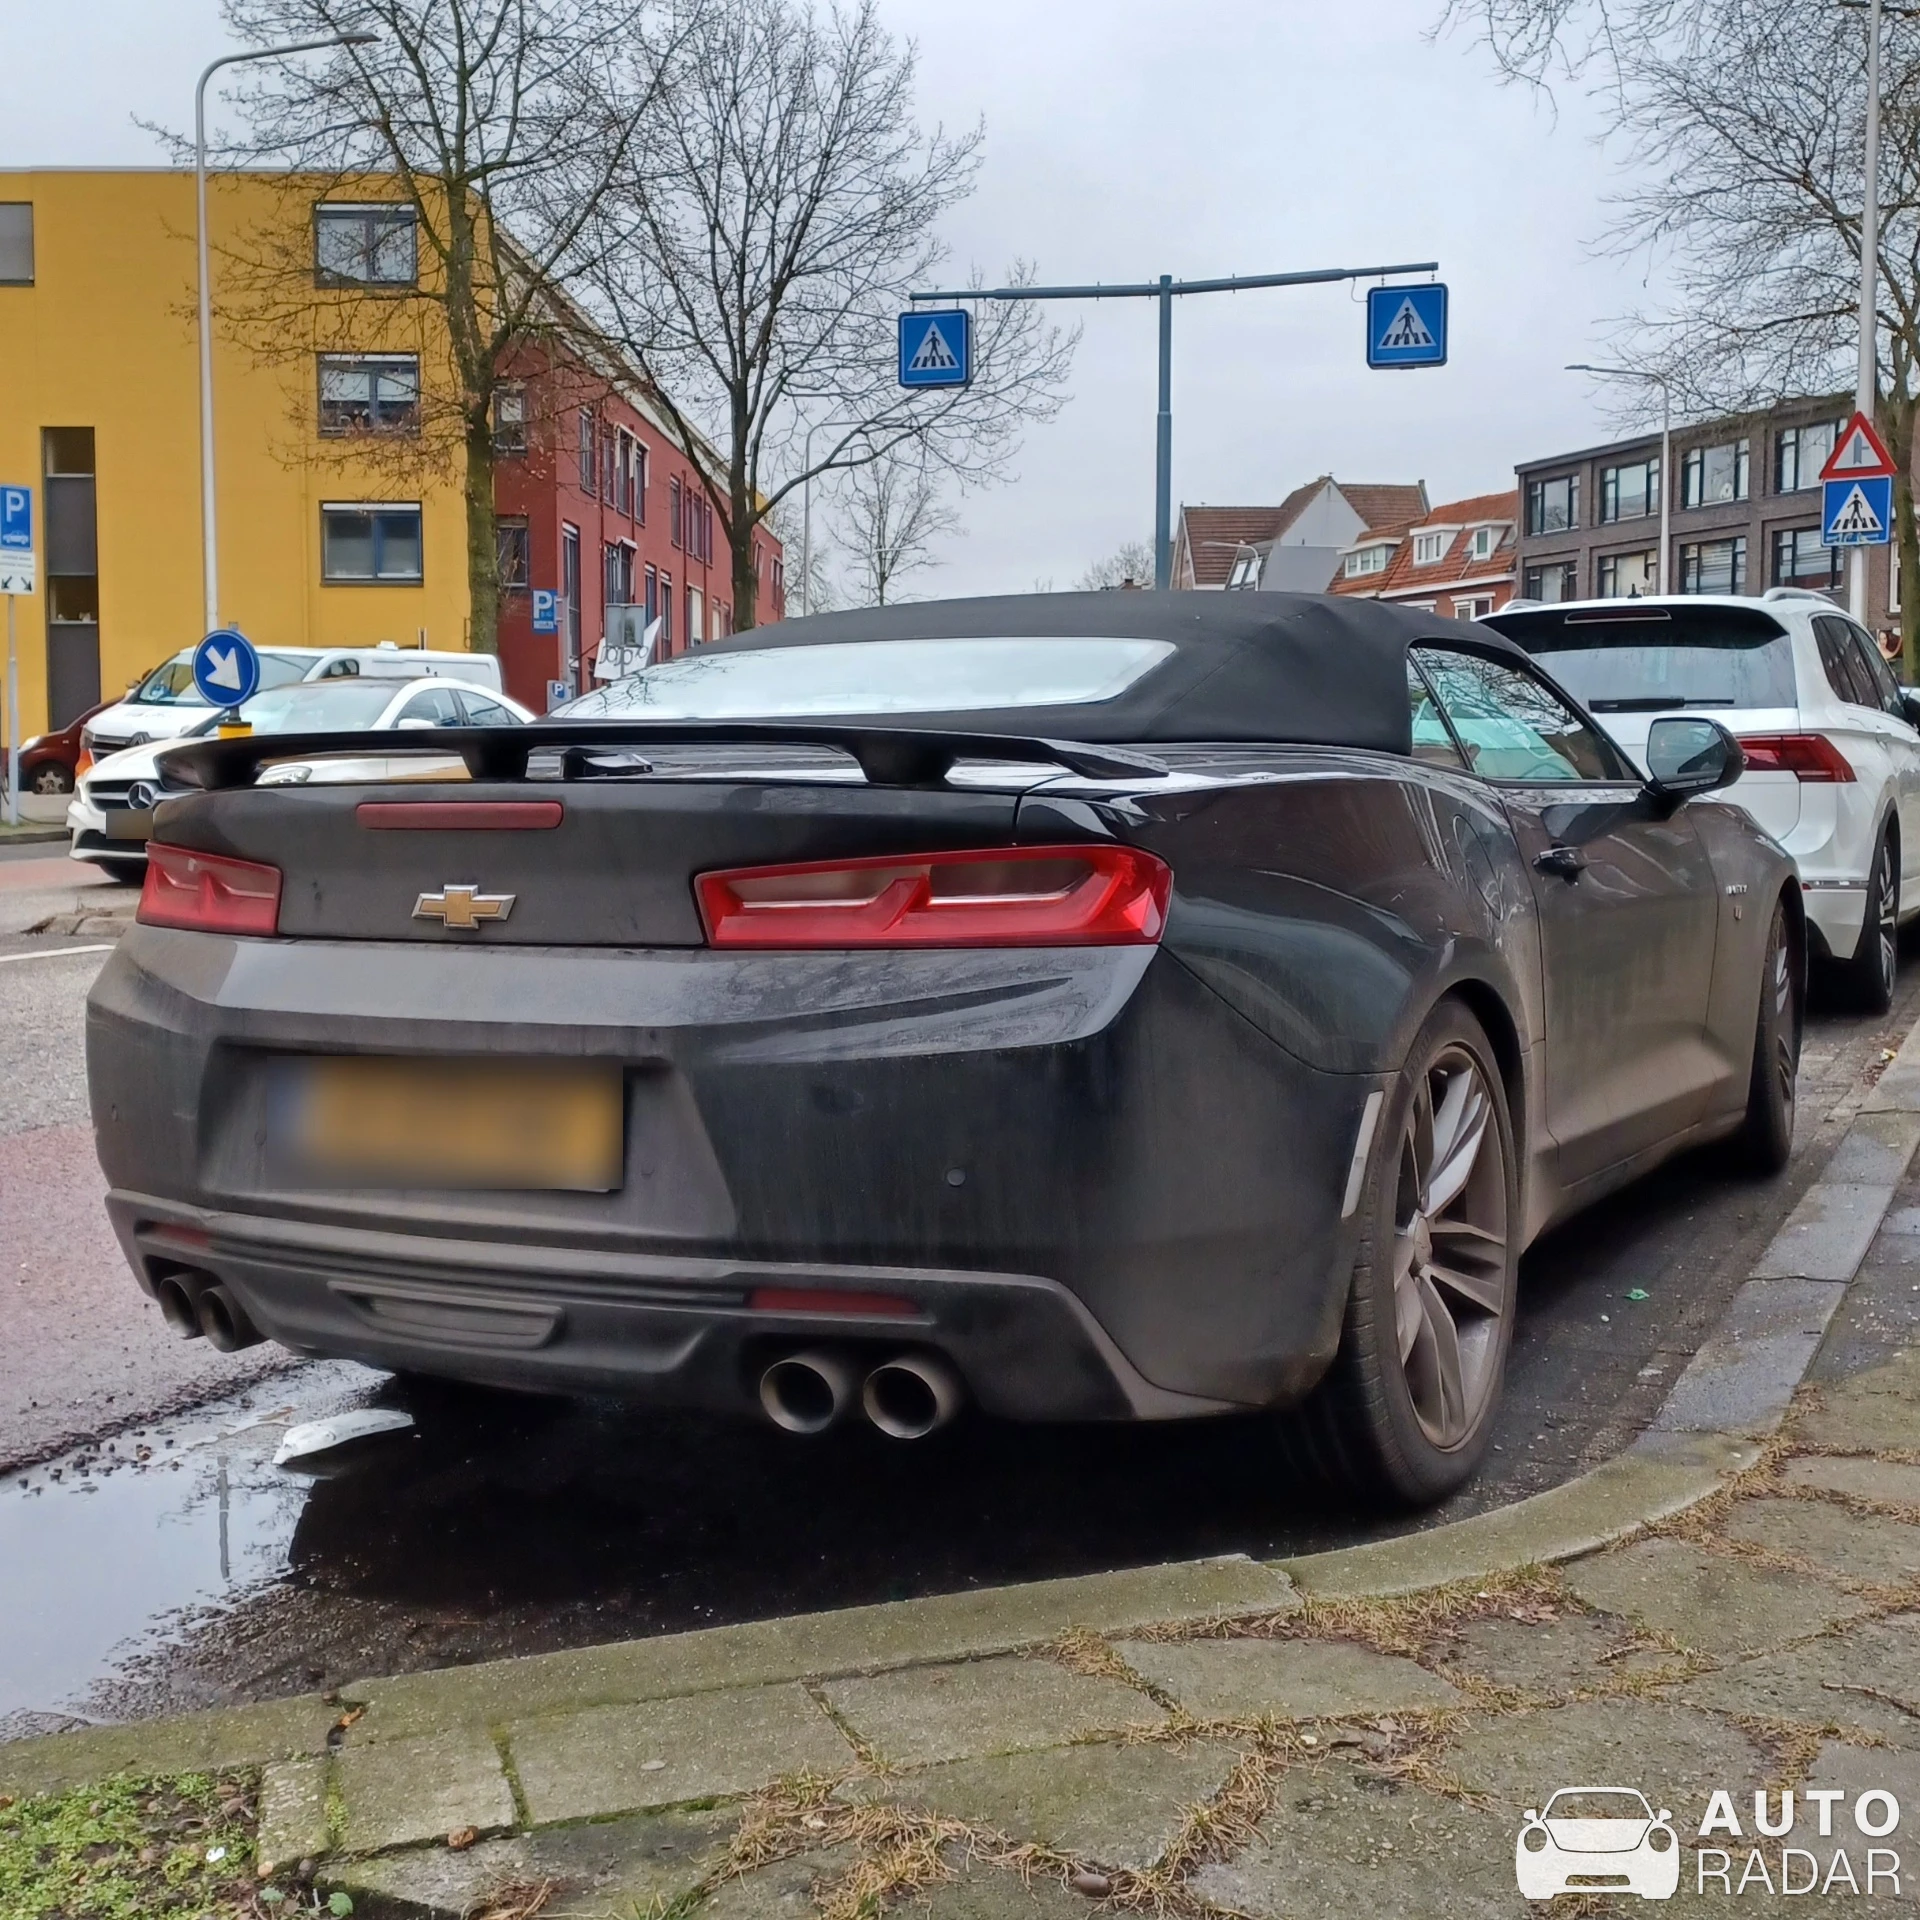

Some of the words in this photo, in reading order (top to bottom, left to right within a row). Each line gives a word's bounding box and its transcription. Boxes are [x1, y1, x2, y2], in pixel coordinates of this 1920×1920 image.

[6, 490, 25, 522] P
[533, 590, 553, 619] P
[554, 683, 564, 696] P
